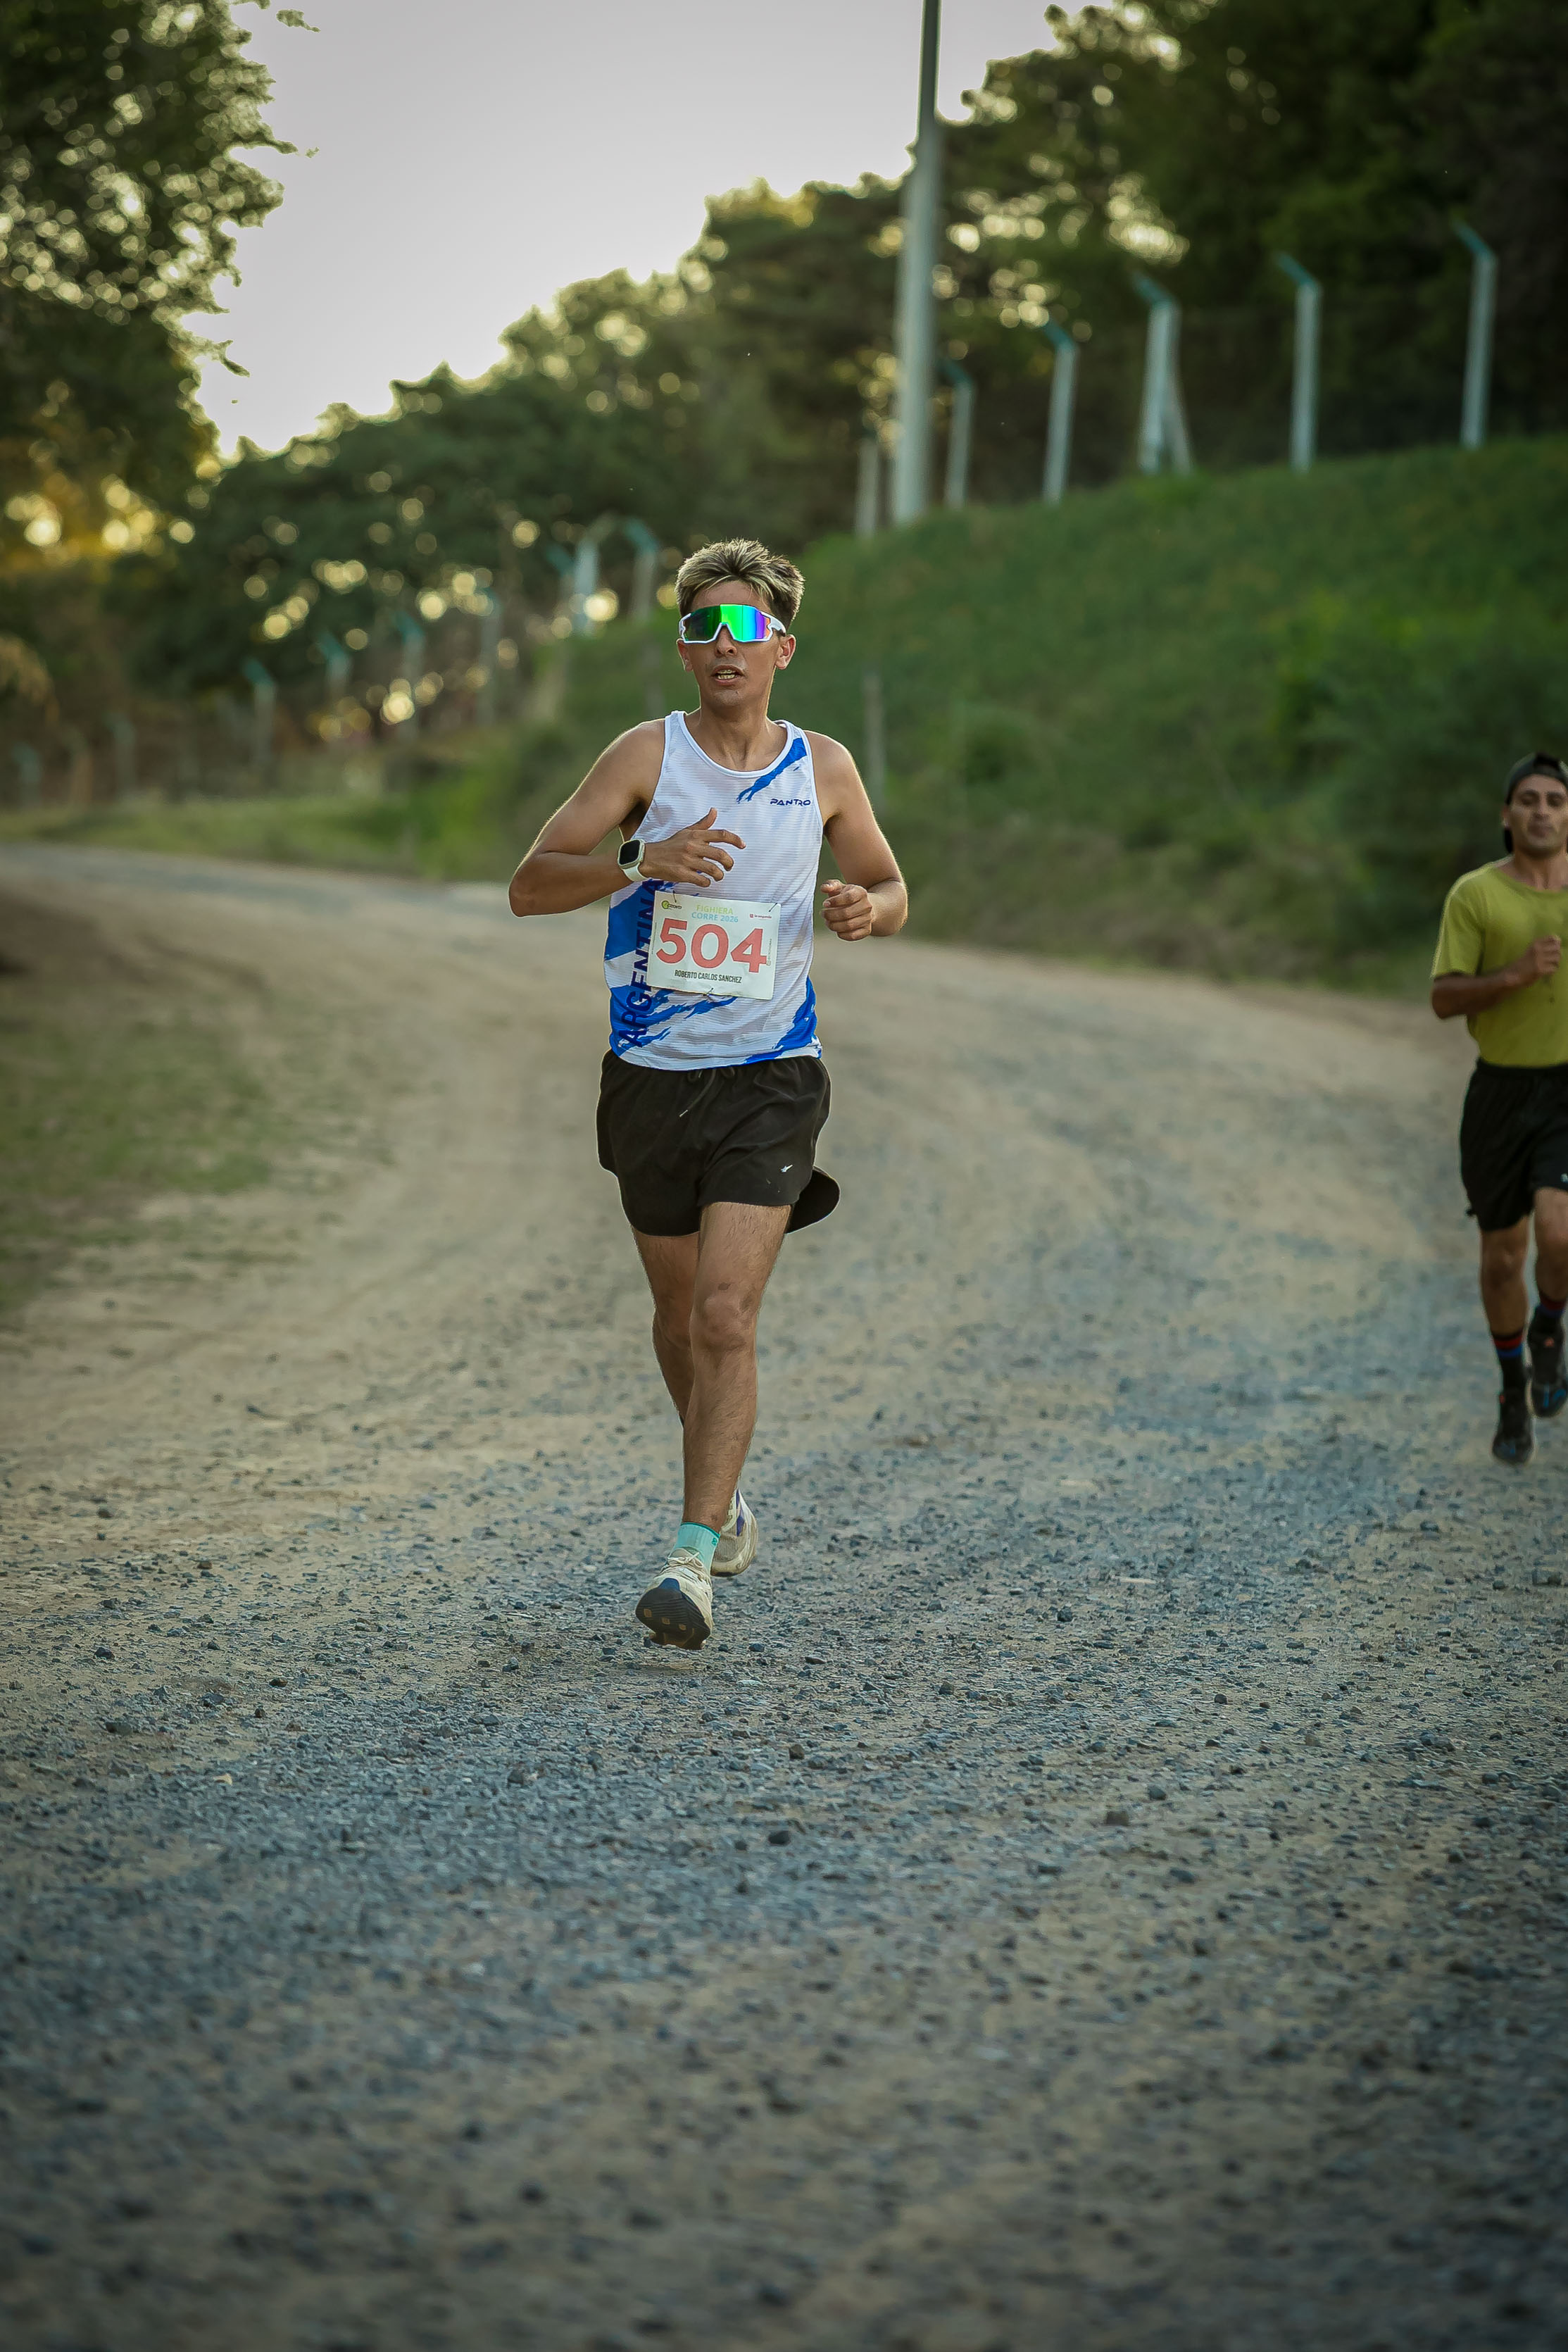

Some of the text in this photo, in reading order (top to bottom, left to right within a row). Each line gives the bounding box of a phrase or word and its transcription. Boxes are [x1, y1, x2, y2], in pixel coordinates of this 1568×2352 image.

[770, 798, 811, 806] PANTRO
[696, 904, 734, 915] FIGHIERA
[691, 912, 718, 921] CORRE
[656, 918, 767, 973] 504
[618, 880, 664, 1047] ARGENTINA
[675, 969, 742, 984] ROBERTO CARLOS SANCHEZ
